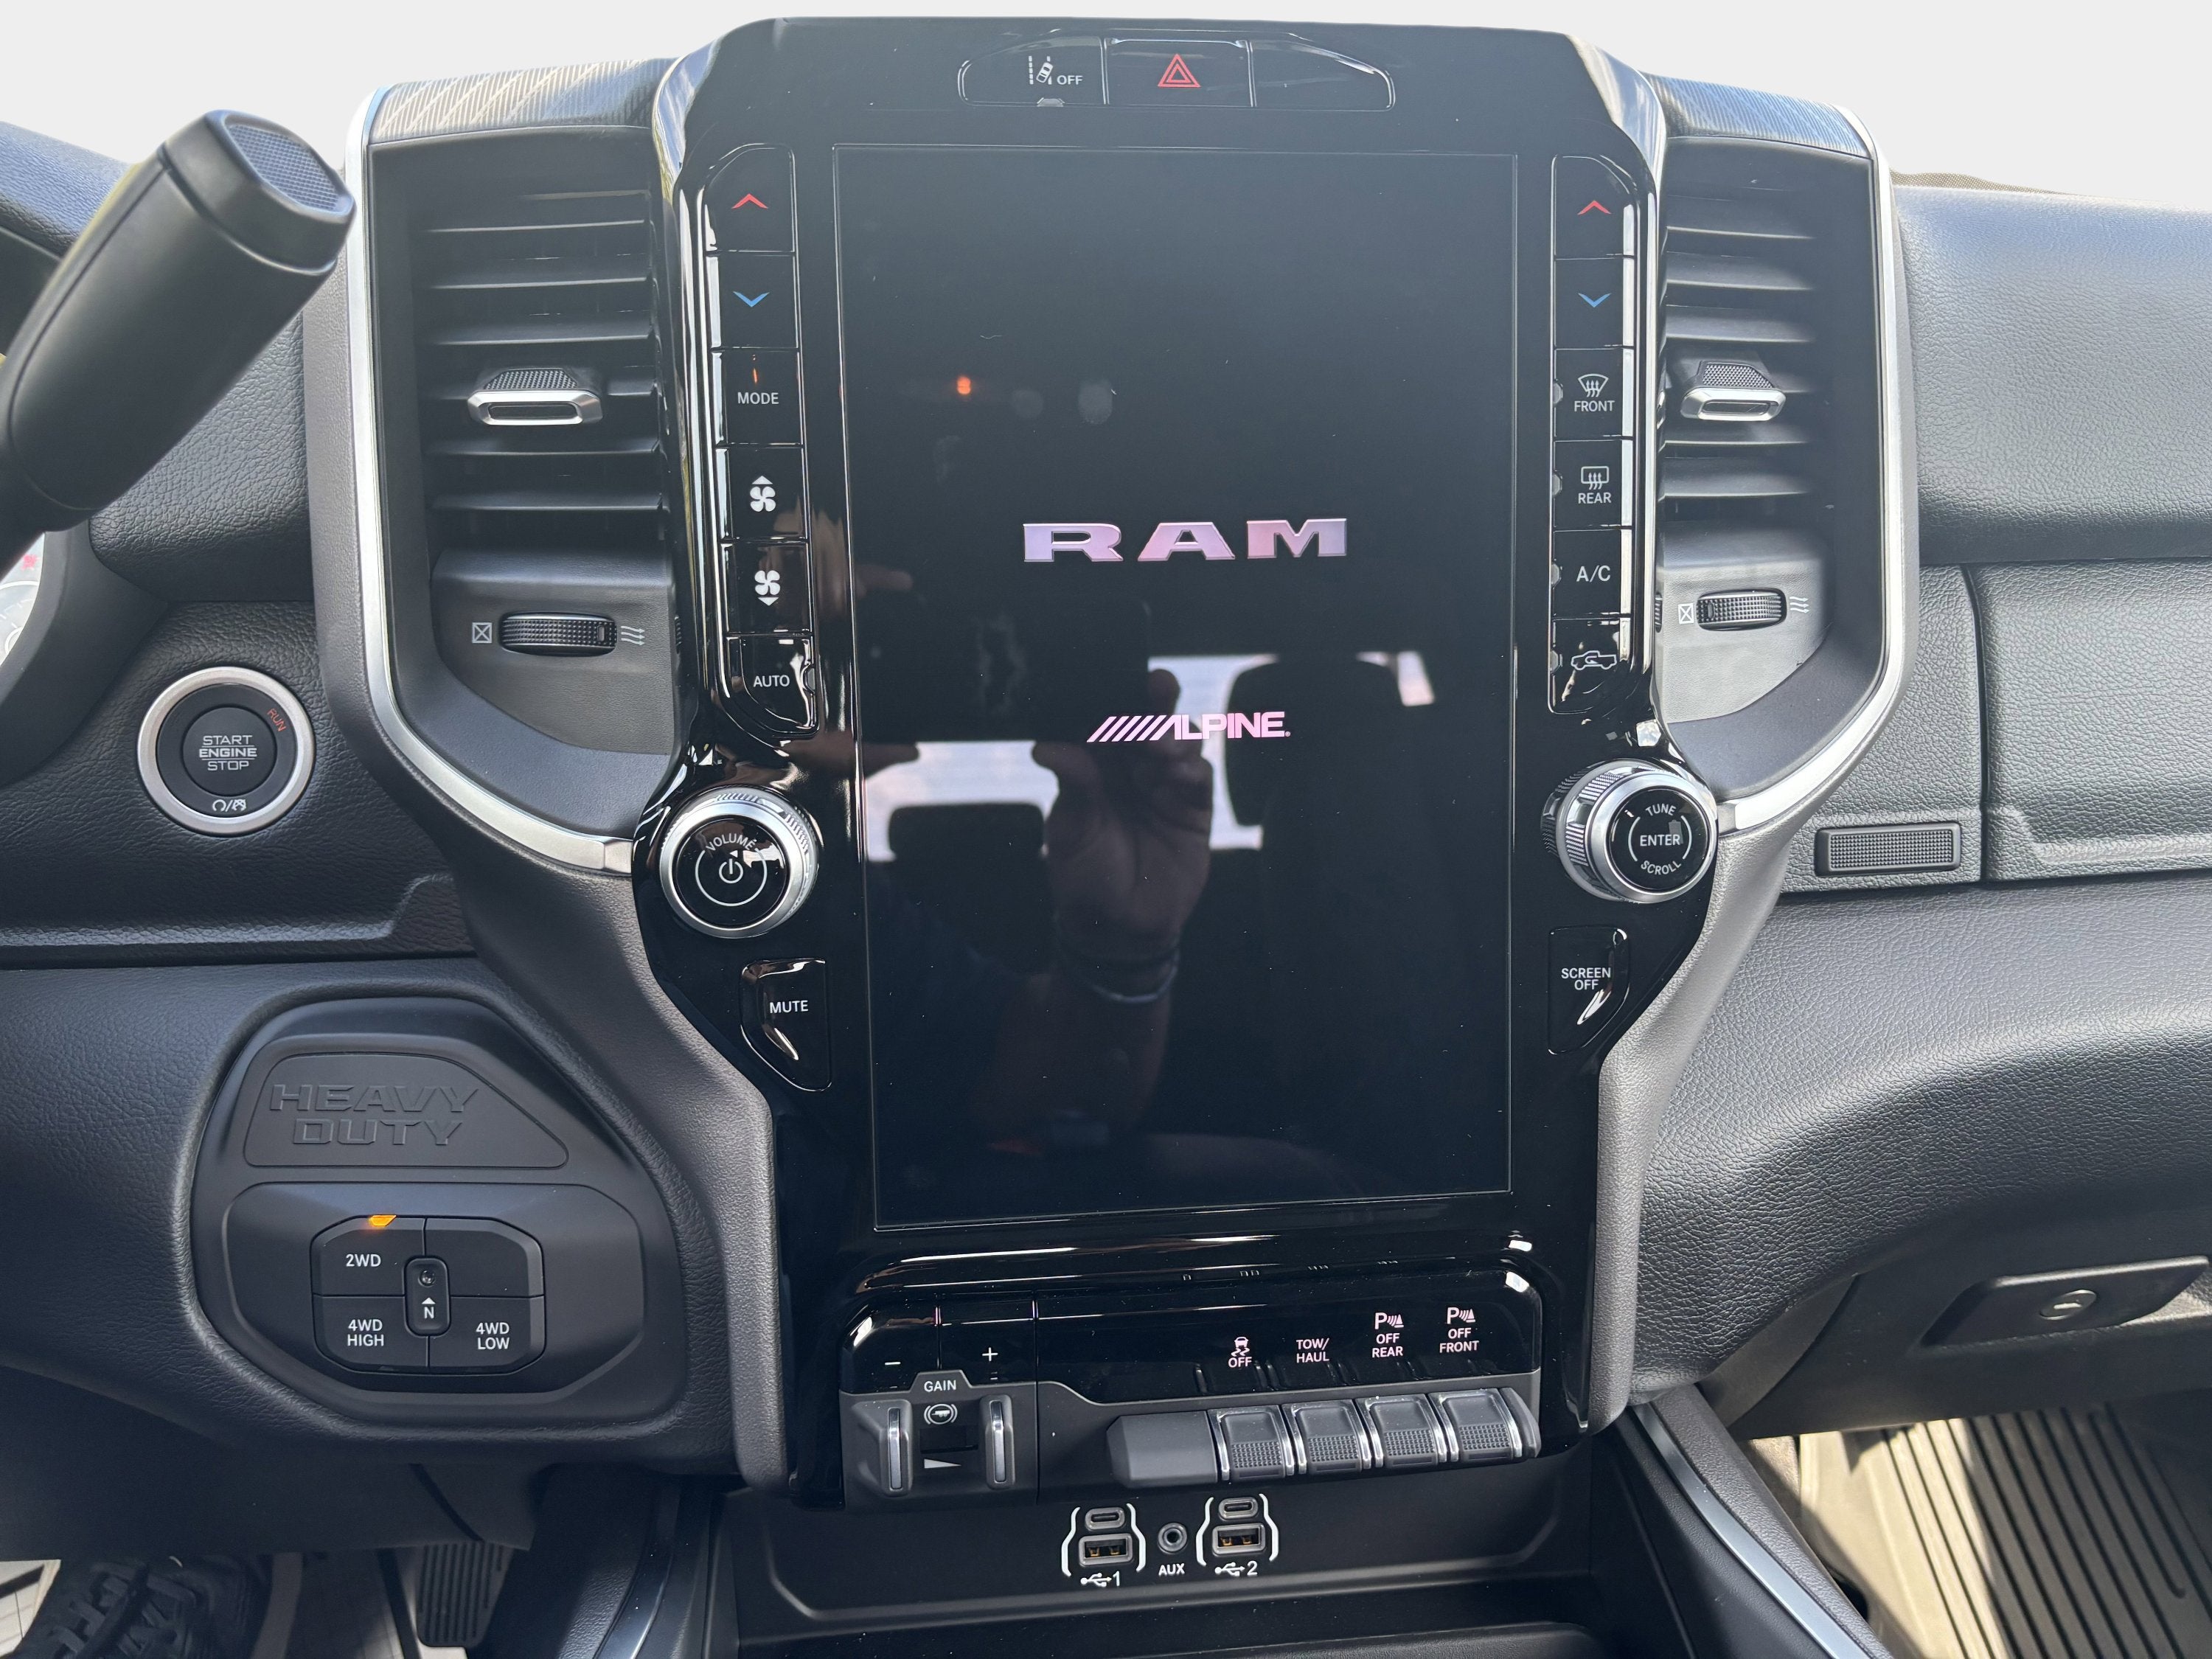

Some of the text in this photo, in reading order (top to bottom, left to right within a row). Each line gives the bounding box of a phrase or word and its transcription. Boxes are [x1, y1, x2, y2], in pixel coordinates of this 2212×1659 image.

[1057, 74, 1083, 86] OFF
[737, 392, 779, 405] MODE
[1574, 400, 1615, 413] FRONT
[1578, 492, 1612, 504] REAR
[1023, 518, 1347, 563] RAM
[1576, 565, 1610, 582] A/C
[753, 674, 790, 688] AUTO
[267, 708, 287, 731] RUN
[203, 735, 253, 745] START
[199, 748, 257, 758] ENGINE
[207, 760, 249, 771] STOP
[1646, 804, 1676, 817] TUNE
[704, 833, 757, 852] VOLUME
[1639, 835, 1680, 847] ENTER
[1641, 860, 1682, 876] SCROLL
[1561, 967, 1612, 979] SCREEN
[1574, 979, 1599, 991] OFF
[769, 1000, 809, 1014] MUTE
[270, 1085, 479, 1113] HEAVY
[293, 1119, 463, 1145] DUTY
[346, 1253, 381, 1267] 2WD
[348, 1318, 383, 1332] 4WD
[476, 1322, 510, 1335] 4WD
[1376, 1332, 1400, 1345] OFF
[1447, 1327, 1472, 1340] OFF
[347, 1334, 385, 1347] HIGH
[477, 1337, 510, 1351] LOW
[1295, 1337, 1330, 1351] TOW/
[1439, 1340, 1480, 1354] FRONT
[1295, 1351, 1330, 1364] HAUL
[1371, 1346, 1404, 1359] REAR
[1228, 1356, 1253, 1368] OFF
[924, 1380, 957, 1393] GAIN
[1158, 1562, 1186, 1576] AUX
